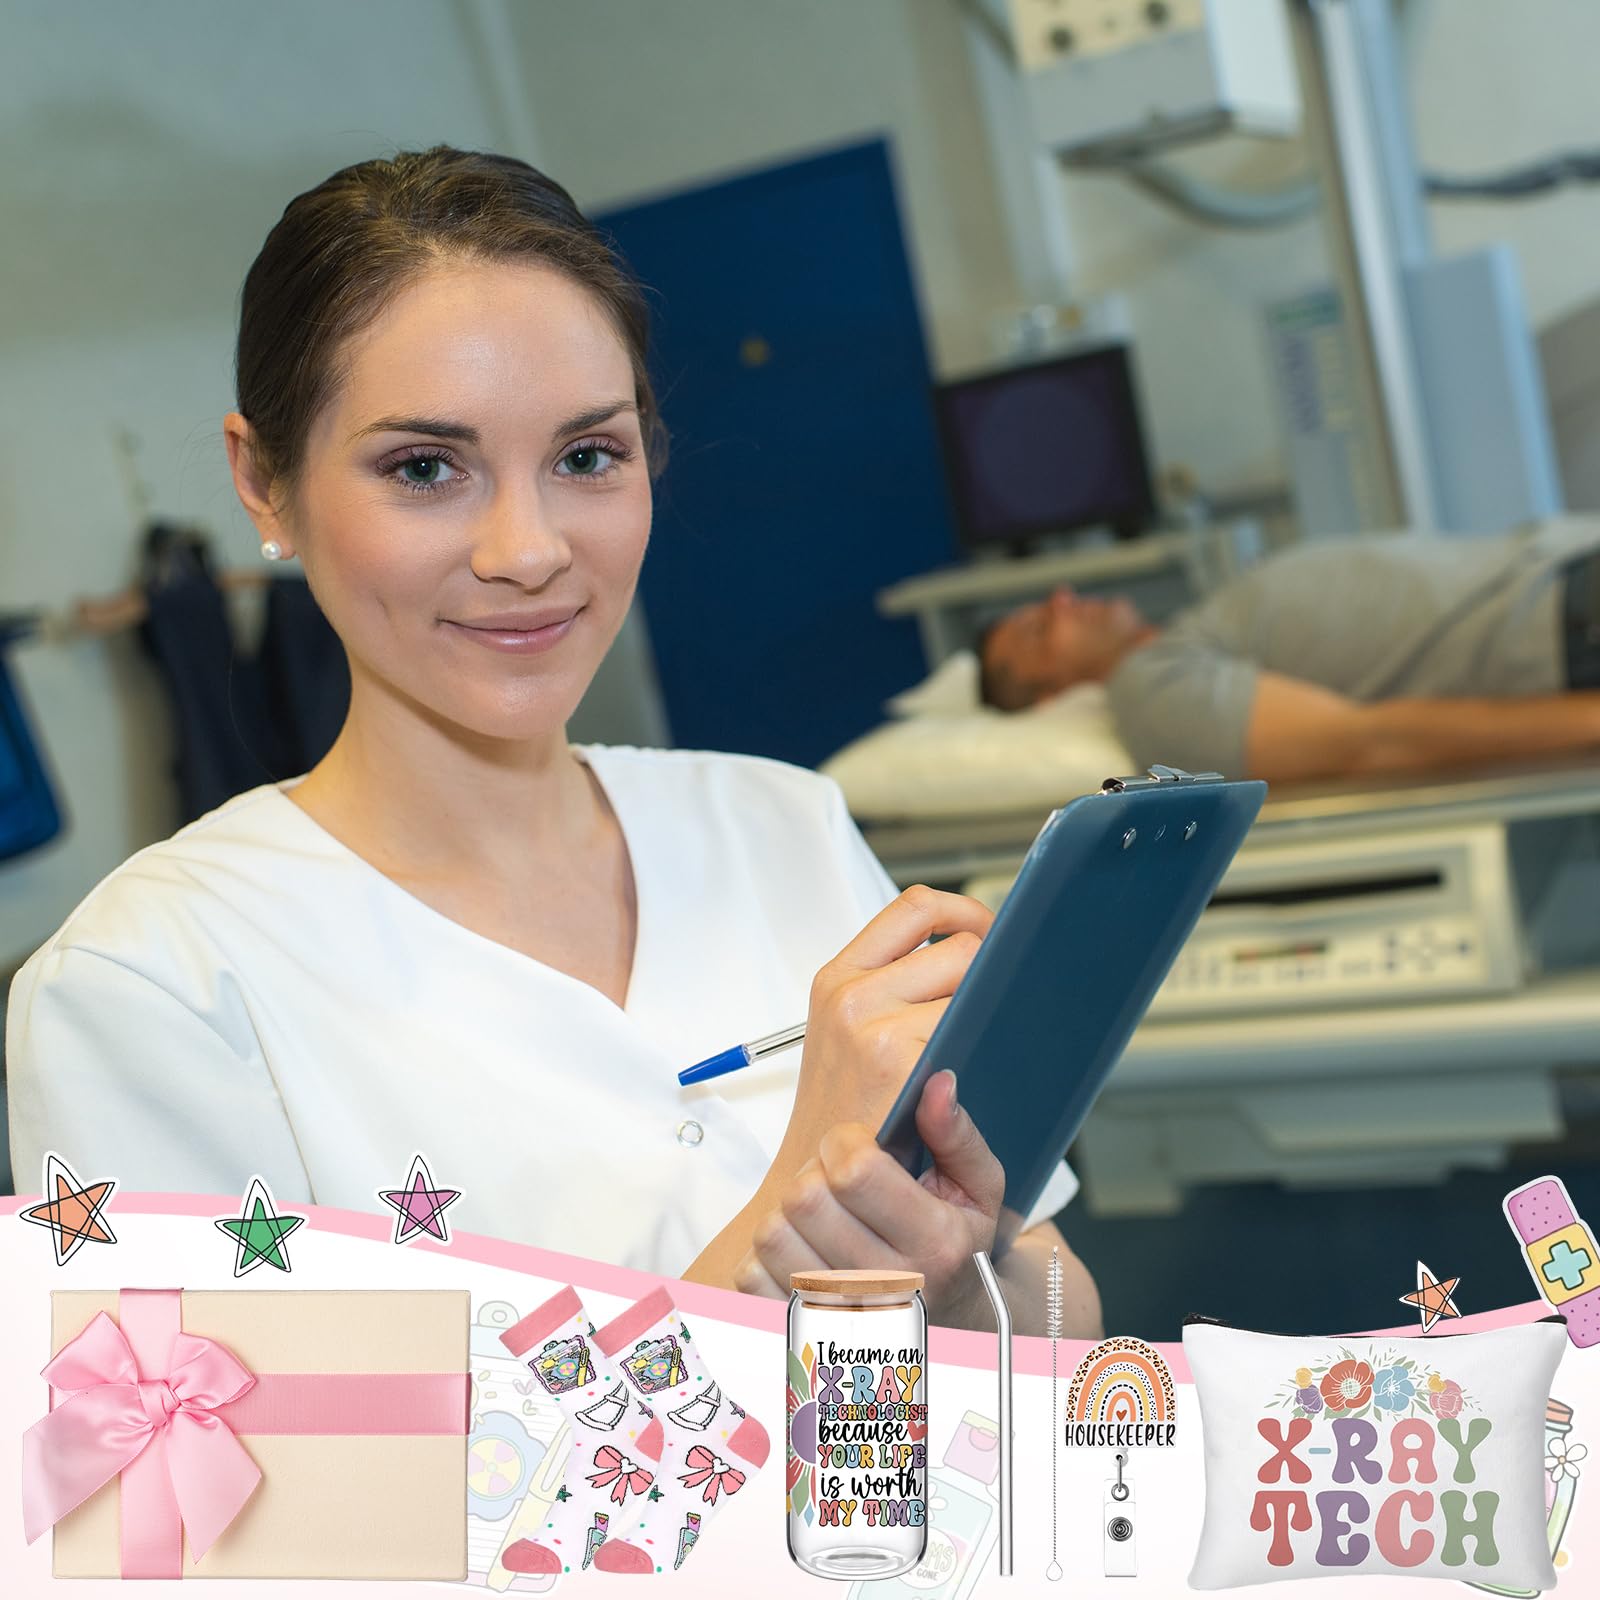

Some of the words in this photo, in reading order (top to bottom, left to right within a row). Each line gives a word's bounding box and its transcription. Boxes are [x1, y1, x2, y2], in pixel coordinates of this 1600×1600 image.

[817, 1342, 825, 1365] I
[828, 1341, 894, 1365] became
[897, 1346, 923, 1365] an
[818, 1365, 922, 1404] X-RAY
[818, 1403, 928, 1421] TECHNOLOGIST
[818, 1419, 908, 1445] because
[1065, 1423, 1176, 1447] HOUSEKEEPER
[817, 1444, 874, 1469] YOUR
[879, 1444, 926, 1469] LIFE
[1257, 1418, 1492, 1485] X-RAY
[820, 1474, 845, 1499] is
[851, 1467, 922, 1499] worth
[818, 1499, 857, 1527] MY
[862, 1499, 926, 1527] TIME
[1249, 1490, 1500, 1567] TECH
